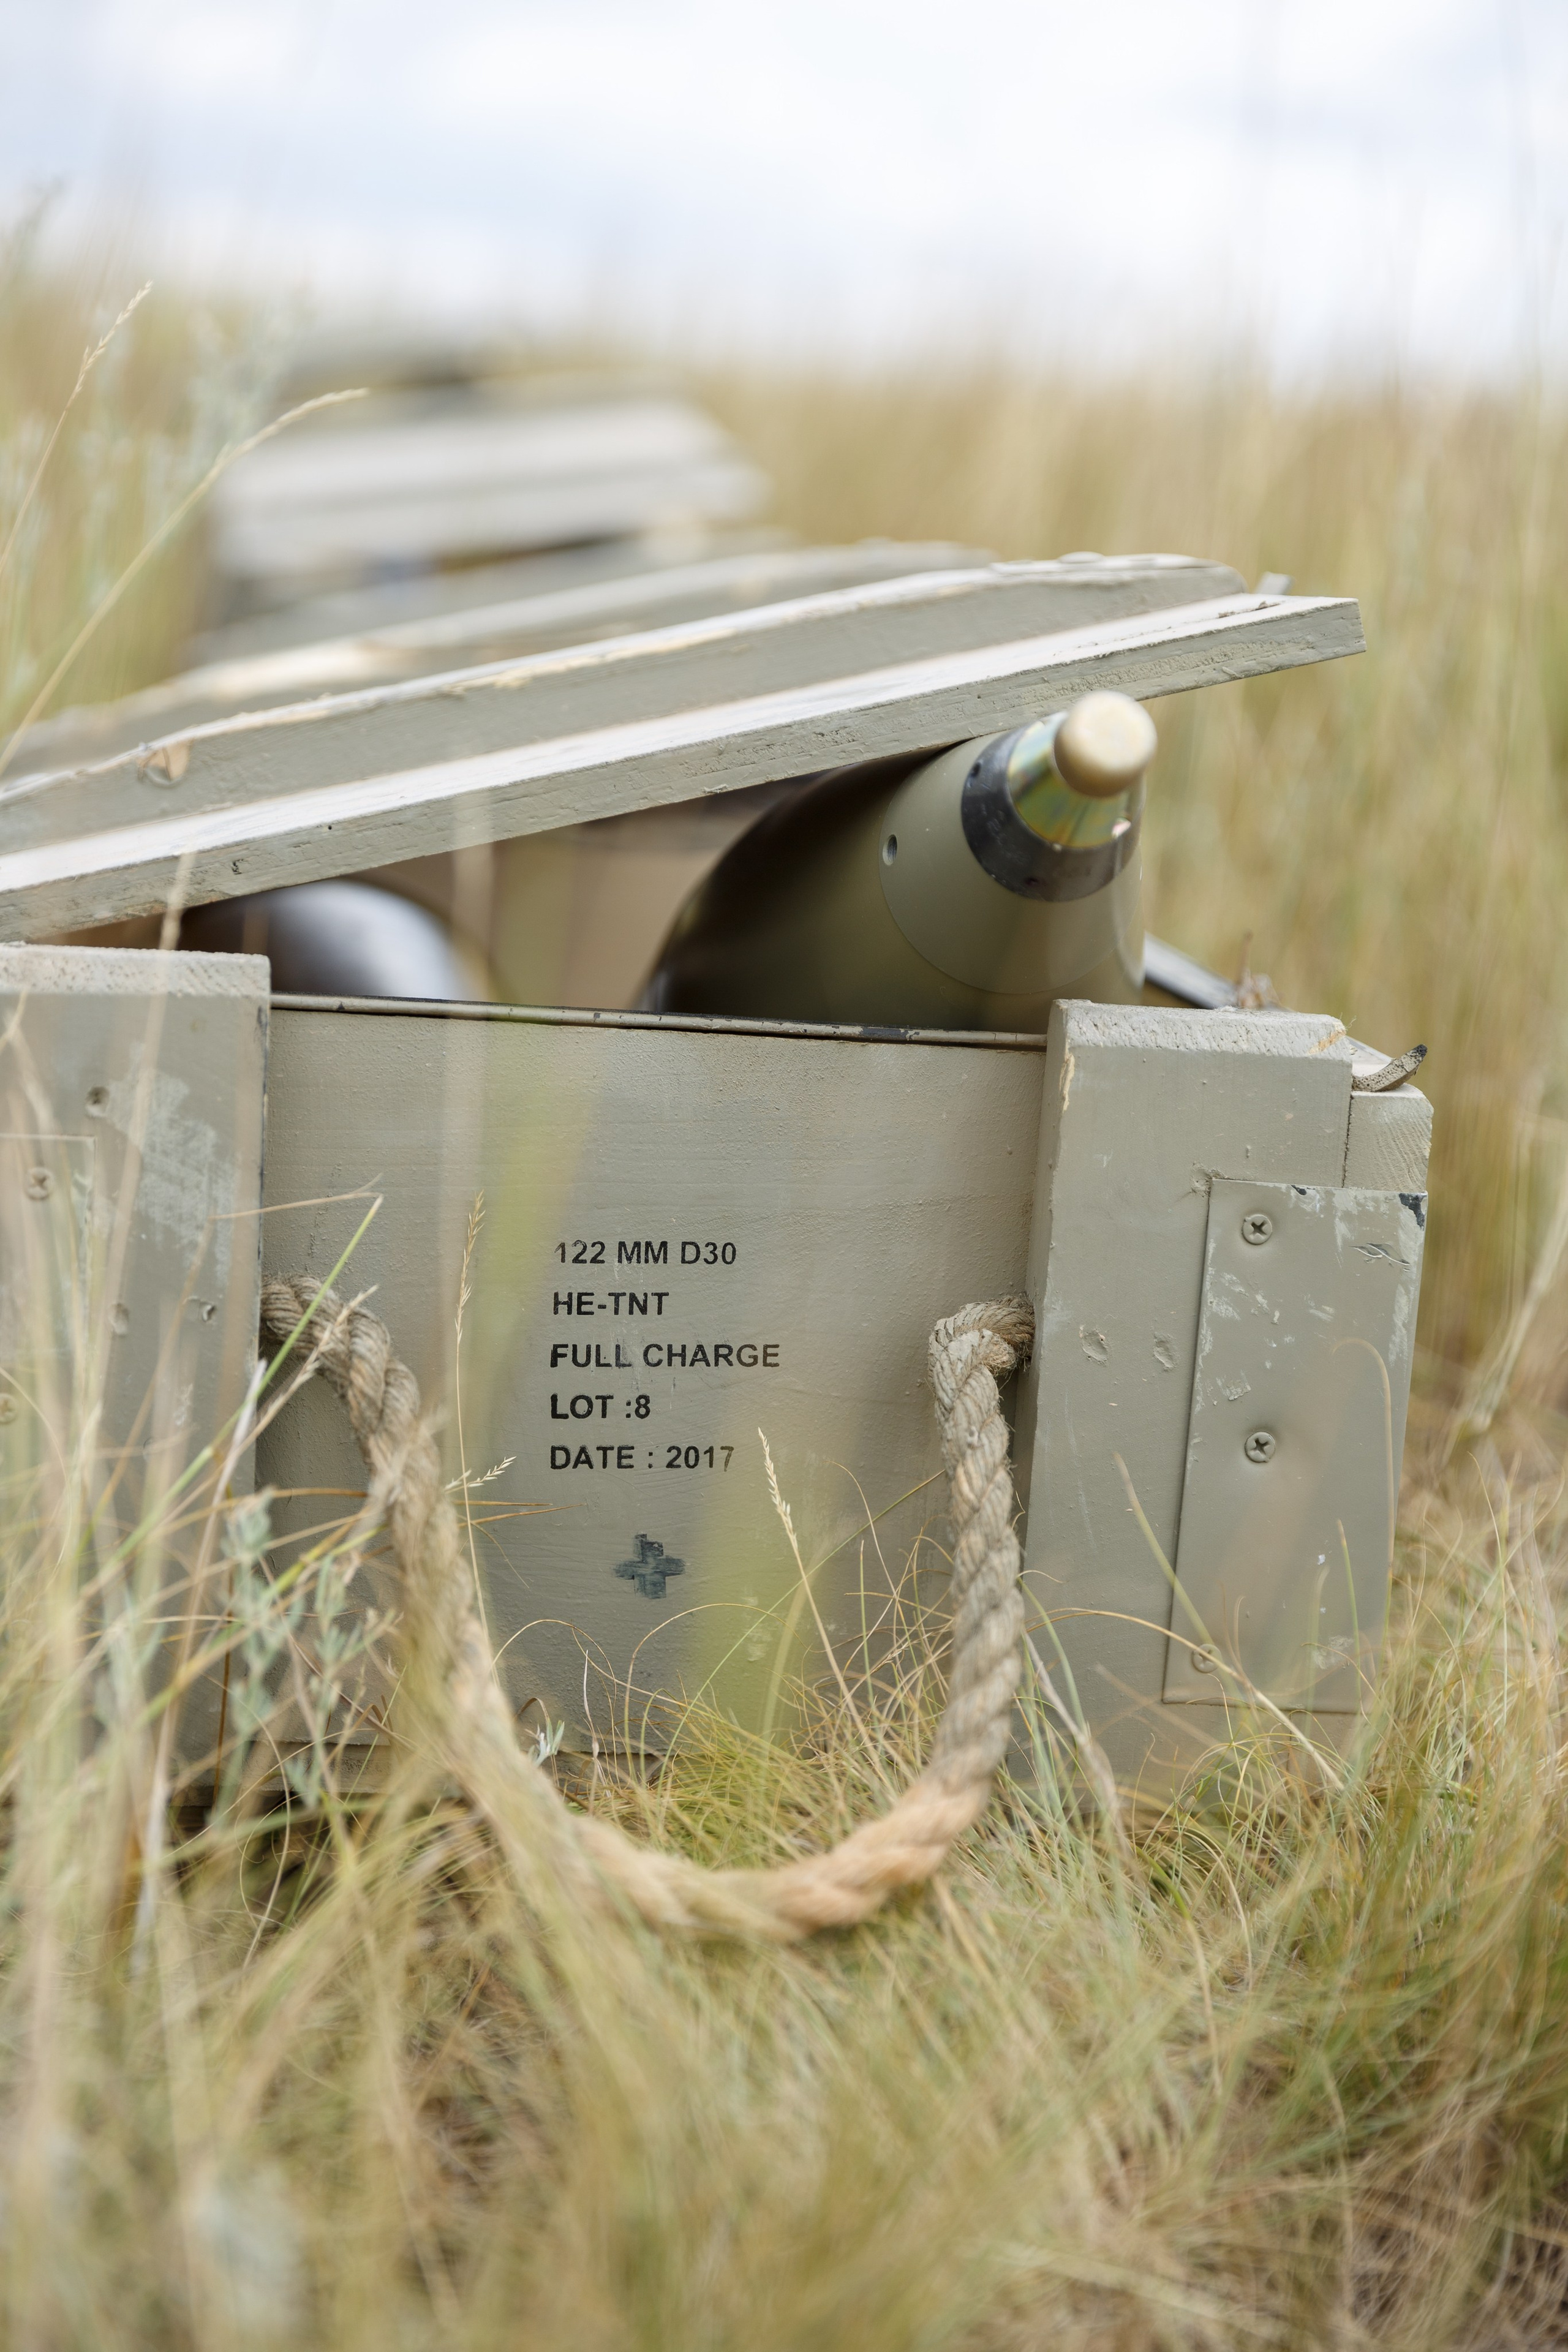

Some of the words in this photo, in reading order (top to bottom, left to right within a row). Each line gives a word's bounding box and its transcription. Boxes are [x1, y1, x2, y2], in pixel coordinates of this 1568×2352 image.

[554, 1240, 606, 1264] 122
[617, 1241, 668, 1264] MM
[680, 1241, 737, 1265] D30
[553, 1292, 669, 1316] HE-TNT
[550, 1344, 632, 1368] FULL
[643, 1343, 780, 1367] CHARGE
[551, 1393, 614, 1420] LOT
[625, 1394, 651, 1419] :8
[550, 1445, 635, 1470] DATE
[665, 1446, 735, 1472] 2017
